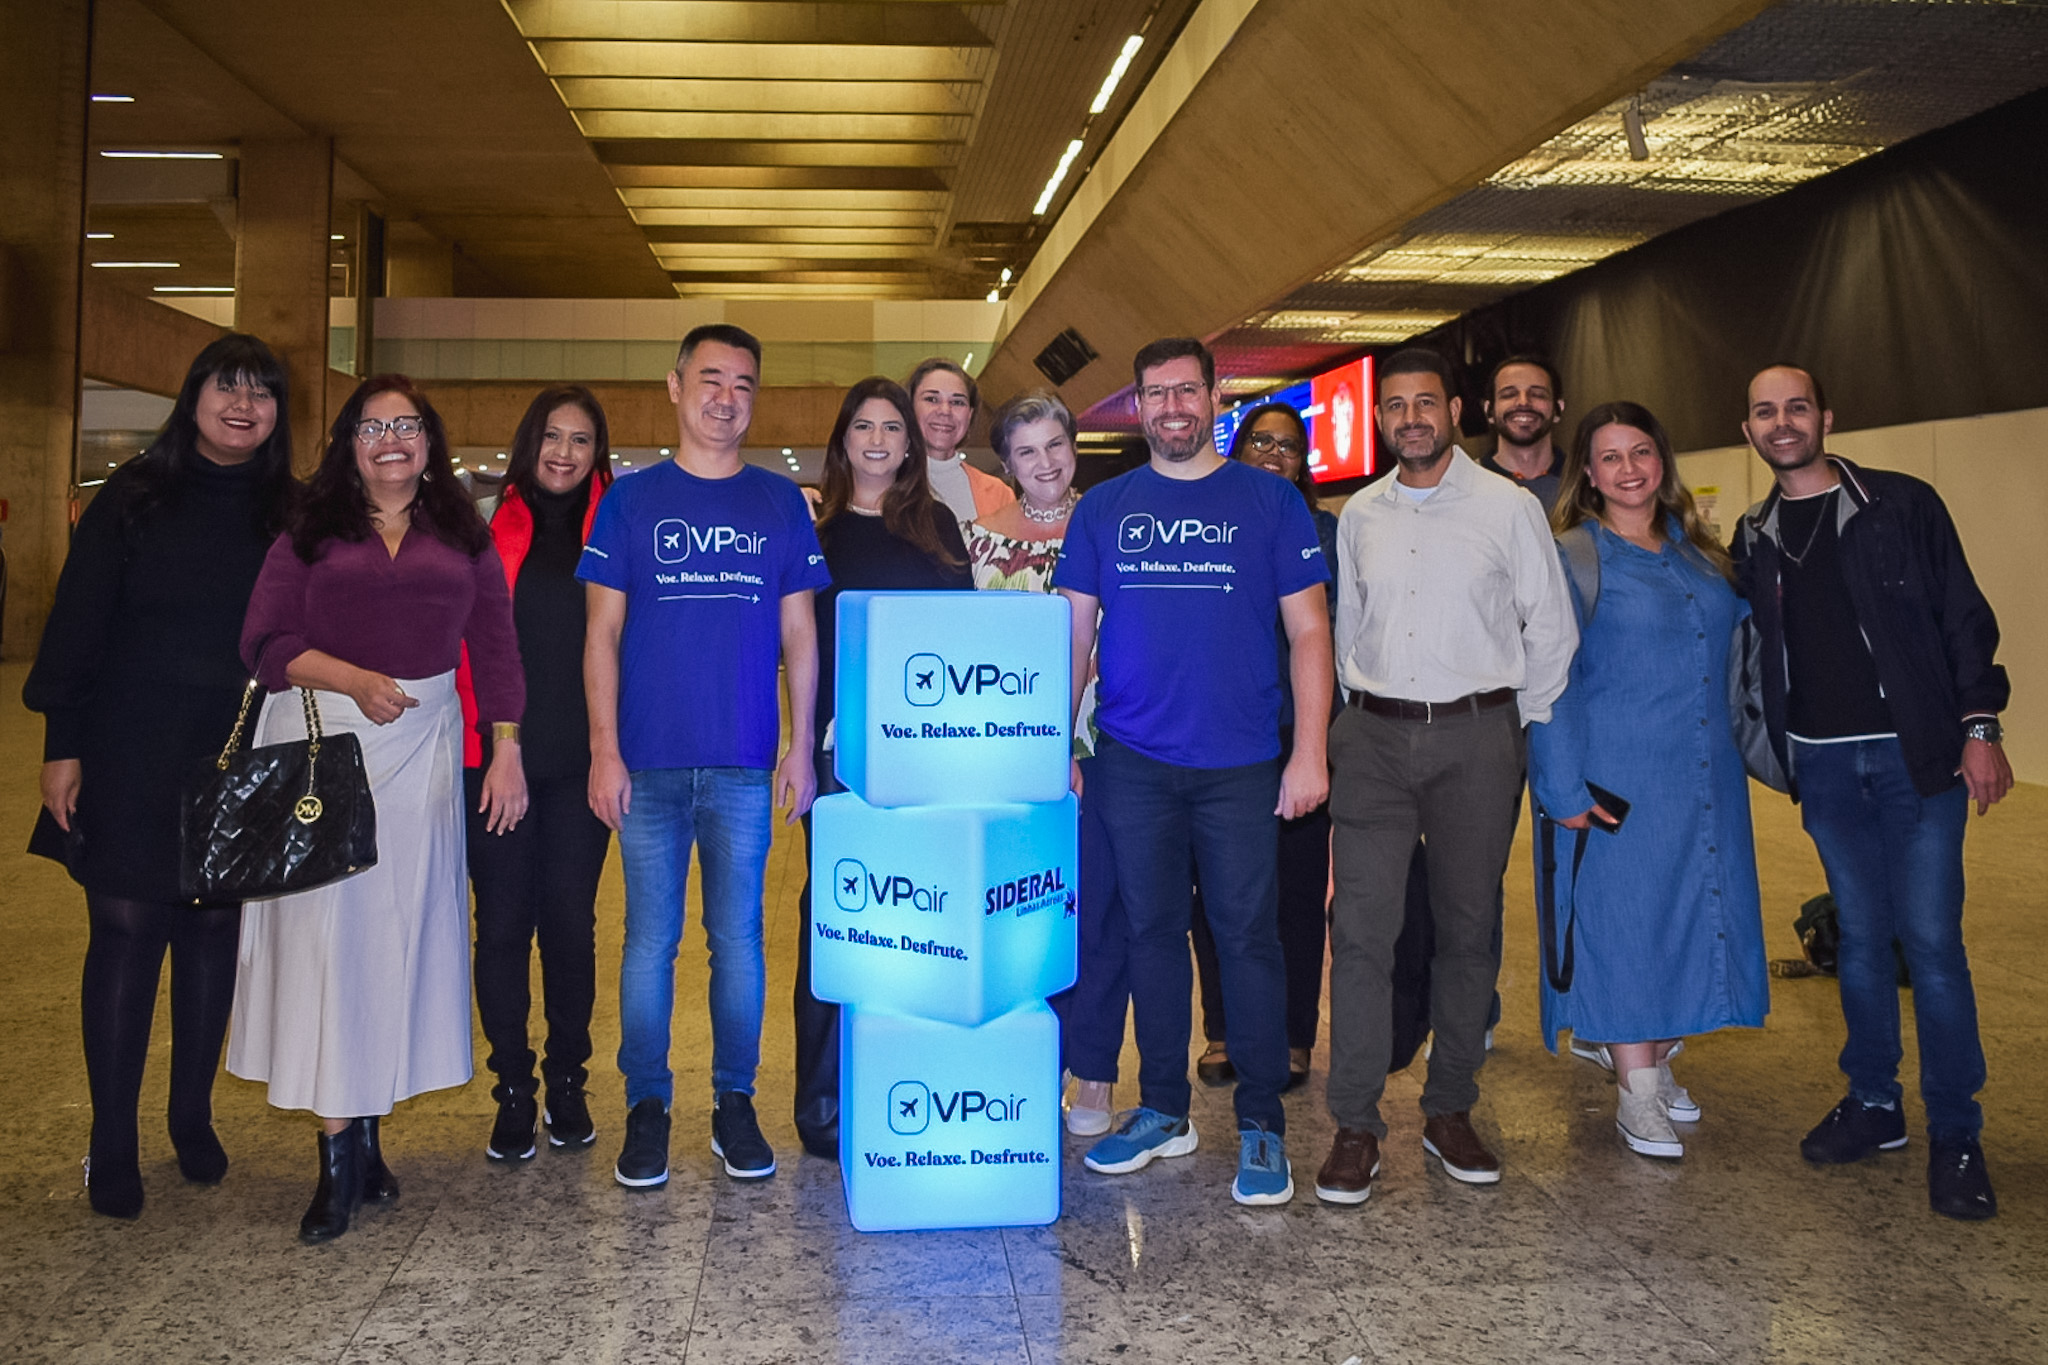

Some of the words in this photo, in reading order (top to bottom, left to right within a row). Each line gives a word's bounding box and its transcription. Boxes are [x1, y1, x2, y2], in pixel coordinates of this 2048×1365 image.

[691, 526, 767, 554] VPair
[1156, 519, 1239, 545] VPair
[656, 573, 679, 585] Voe.
[680, 571, 718, 583] Relaxe.
[720, 572, 764, 585] Desfrute.
[1116, 562, 1138, 574] Voe.
[1140, 561, 1181, 573] Relaxe.
[1183, 562, 1236, 574] Desfrute.
[947, 664, 1040, 695] VPair
[881, 723, 917, 738] Voe.
[921, 722, 981, 738] Relaxe.
[985, 721, 1061, 738] Desfrute.
[869, 873, 948, 913] VPair
[985, 866, 1065, 916] SIDERAL
[816, 922, 845, 941] Voe.
[848, 927, 898, 949] Relaxe.
[901, 935, 968, 961] Desfrute.
[932, 1091, 1027, 1123] VPair
[865, 1152, 901, 1168] Voe.
[906, 1150, 966, 1167] Relaxe.
[971, 1149, 1050, 1165] Desfrute.
